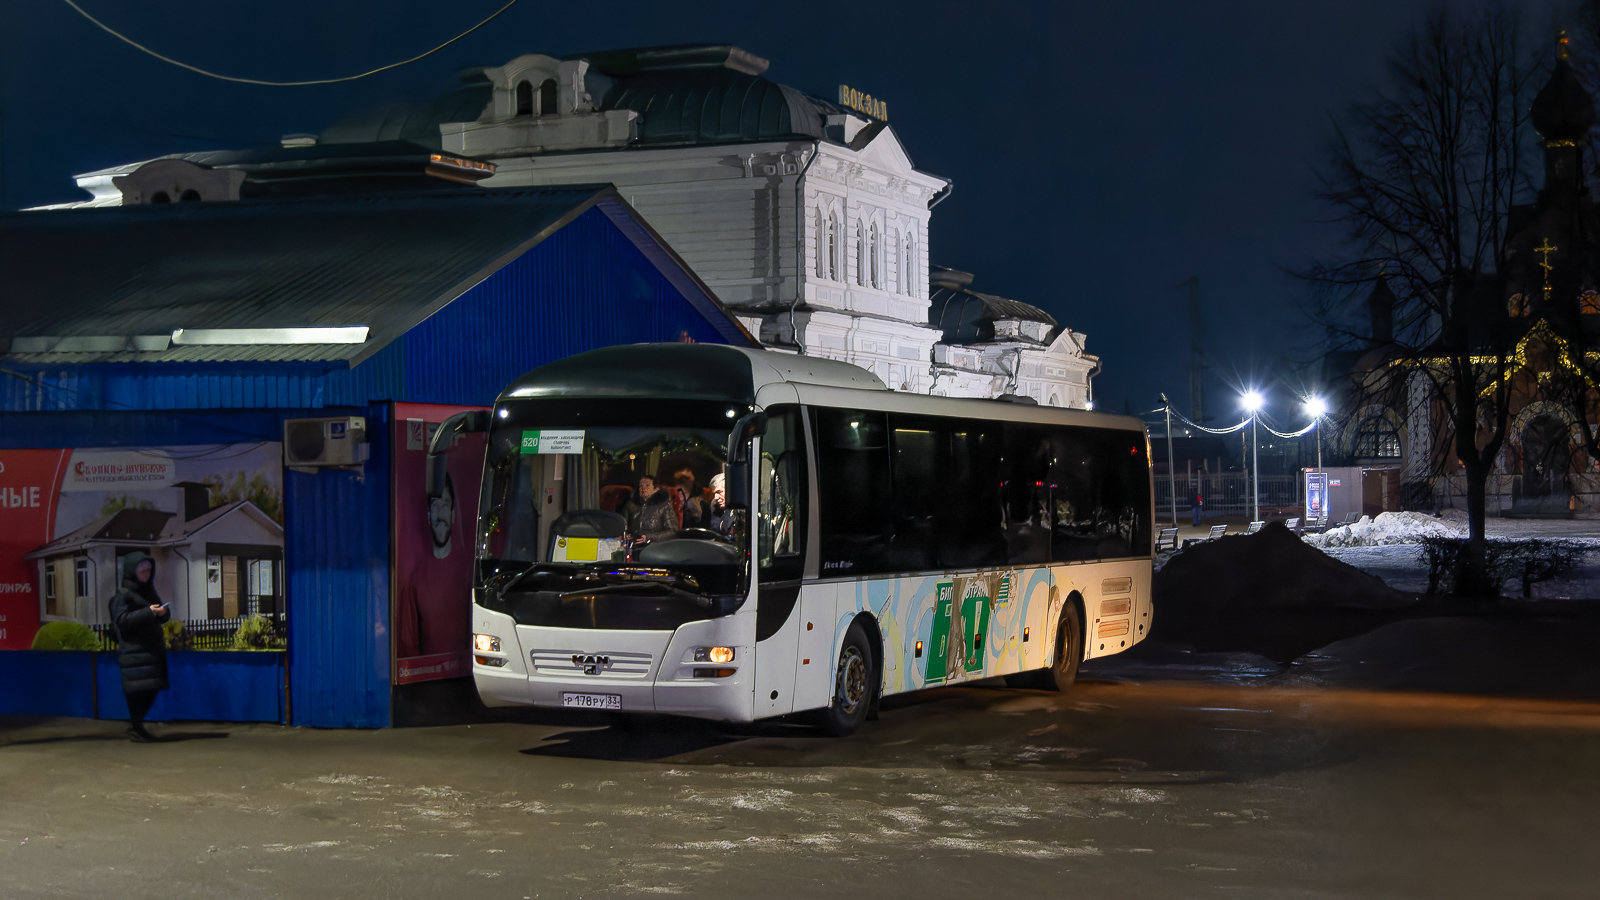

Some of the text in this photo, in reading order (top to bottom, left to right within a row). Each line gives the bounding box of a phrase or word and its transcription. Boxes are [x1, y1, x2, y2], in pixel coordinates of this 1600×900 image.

[839, 84, 888, 122] ВОКЗАЛ
[523, 437, 538, 447] 520
[571, 654, 610, 664] MAN
